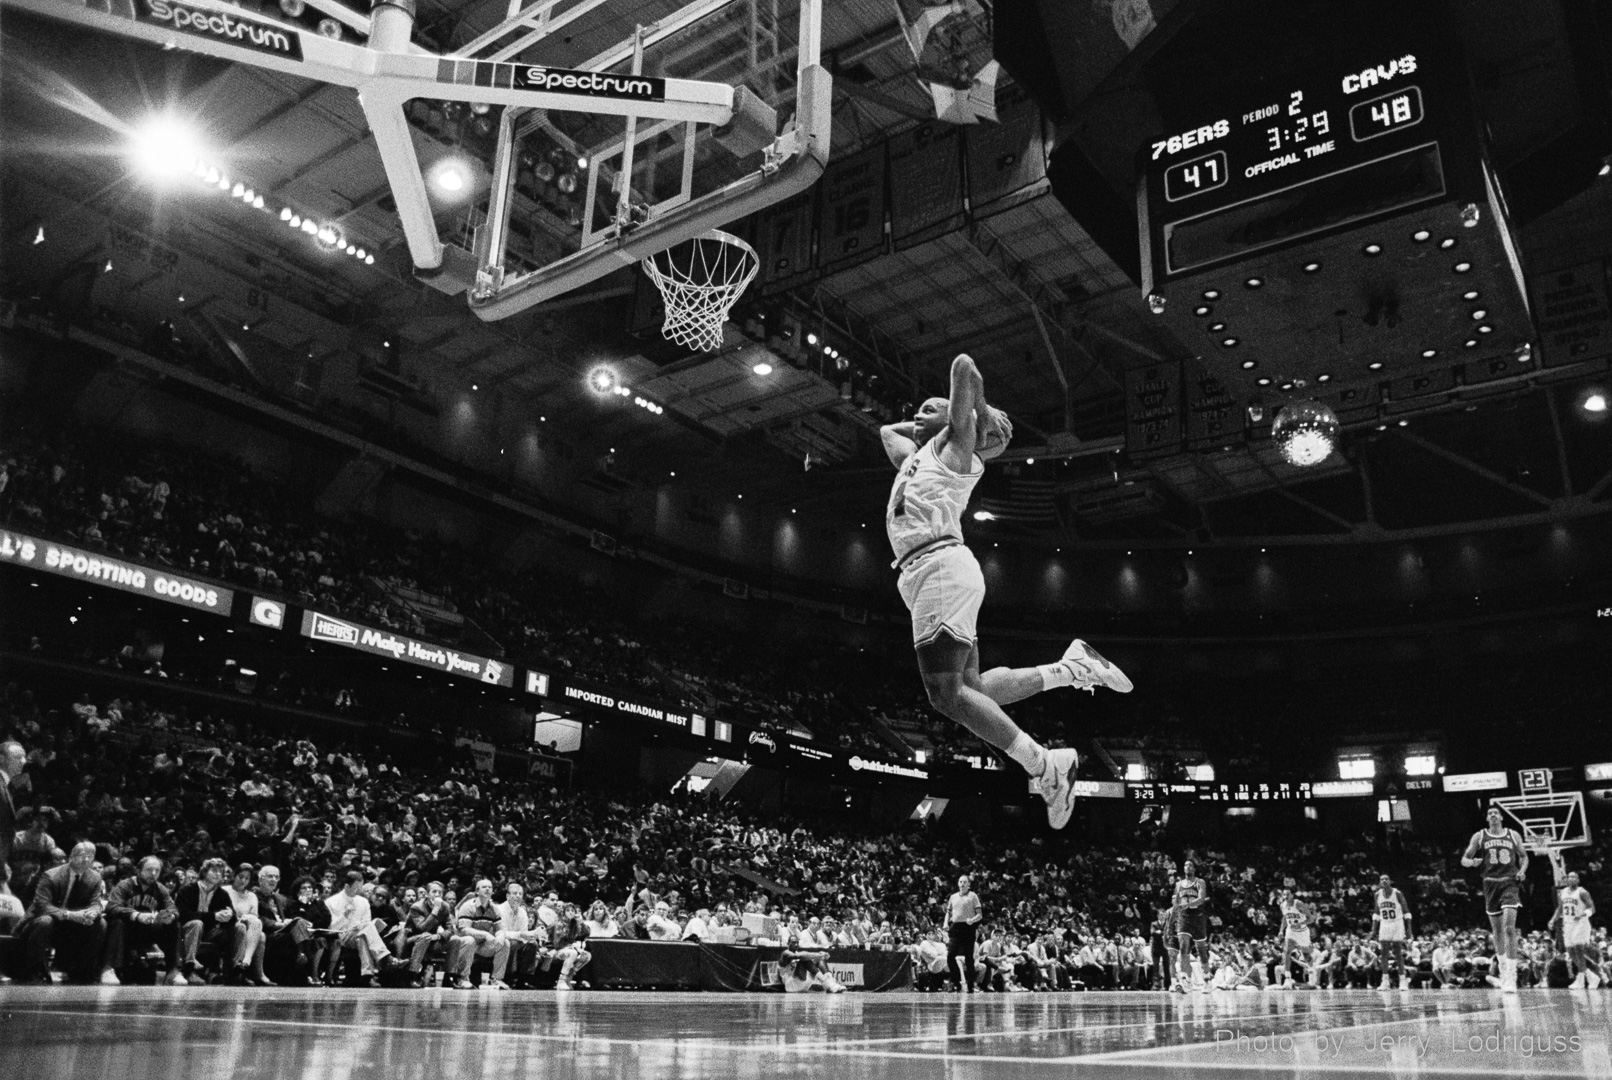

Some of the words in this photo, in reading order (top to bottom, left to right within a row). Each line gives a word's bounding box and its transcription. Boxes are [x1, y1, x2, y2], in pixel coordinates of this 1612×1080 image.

[150, 0, 289, 51] Spectrum
[527, 68, 652, 95] Spectrum
[1342, 54, 1418, 94] CAVS
[1242, 103, 1280, 125] PERIOD
[1288, 90, 1303, 116] 2
[1371, 95, 1412, 126] 48
[1151, 119, 1230, 160] 76ERS
[1267, 110, 1330, 151] 3:29
[1183, 159, 1219, 188] 47
[1244, 152, 1301, 178] OFFICIAL
[1304, 140, 1336, 159] TIME
[835, 196, 870, 237] 16
[776, 218, 793, 253] 7
[0, 534, 36, 561] L'S
[45, 545, 146, 588] SPORTING
[154, 577, 218, 606] GOODS
[254, 601, 282, 627] G
[361, 629, 405, 658] Make
[408, 641, 446, 664] Herr's
[446, 651, 480, 673] Yours
[529, 673, 546, 695] H
[565, 686, 614, 708] IMPORTED
[617, 701, 663, 721] CANADIAN
[666, 713, 687, 726] MIST
[1135, 789, 1154, 799] 3:29
[1239, 784, 1248, 792] 31
[1406, 781, 1432, 789] DELTA
[1524, 771, 1546, 787] 23
[1489, 849, 1511, 864] 18
[1382, 910, 1396, 920] 20
[1564, 906, 1575, 916] 31
[831, 968, 855, 982] trum
